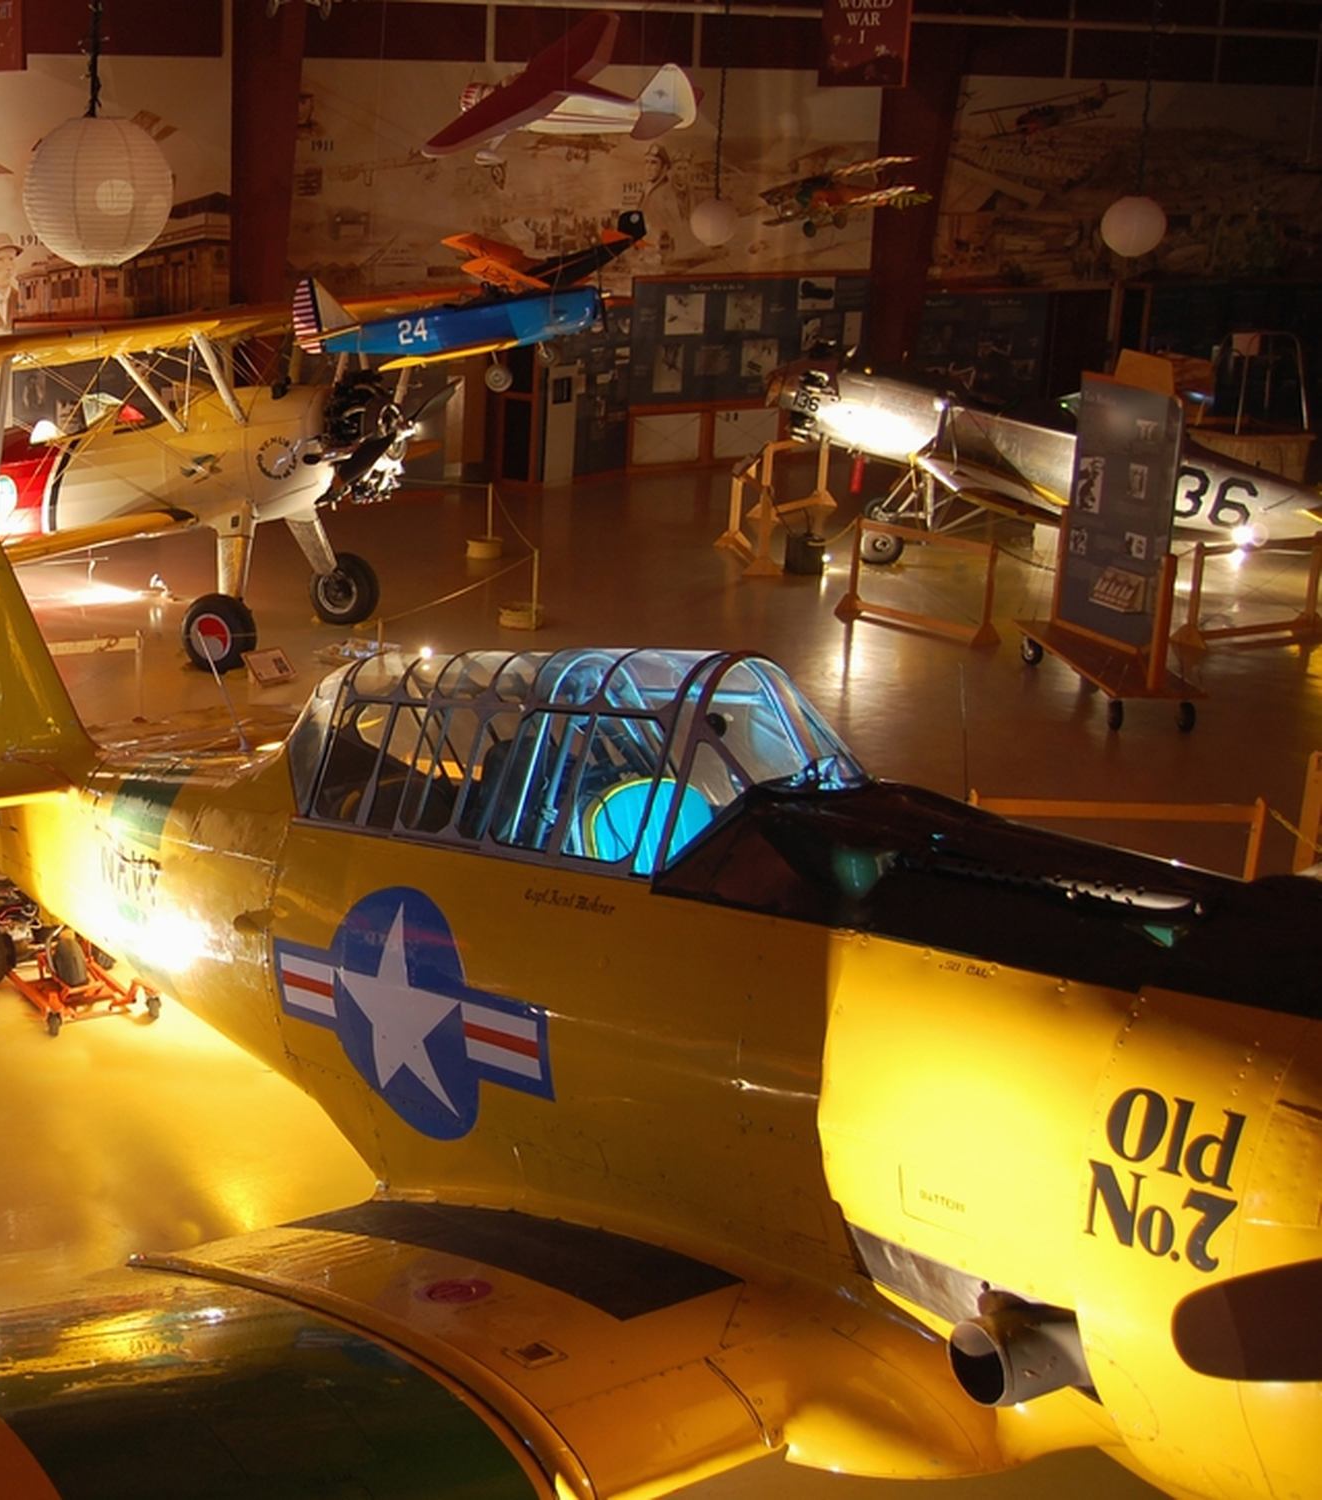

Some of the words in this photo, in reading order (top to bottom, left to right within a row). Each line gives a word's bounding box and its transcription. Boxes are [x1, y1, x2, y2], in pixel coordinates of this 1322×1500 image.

[846, 11, 881, 26] WAR
[397, 316, 428, 345] 24
[792, 390, 821, 412] 136
[101, 846, 158, 907] NAVY
[1104, 1085, 1247, 1192] Old
[1083, 1158, 1239, 1274] No.7
